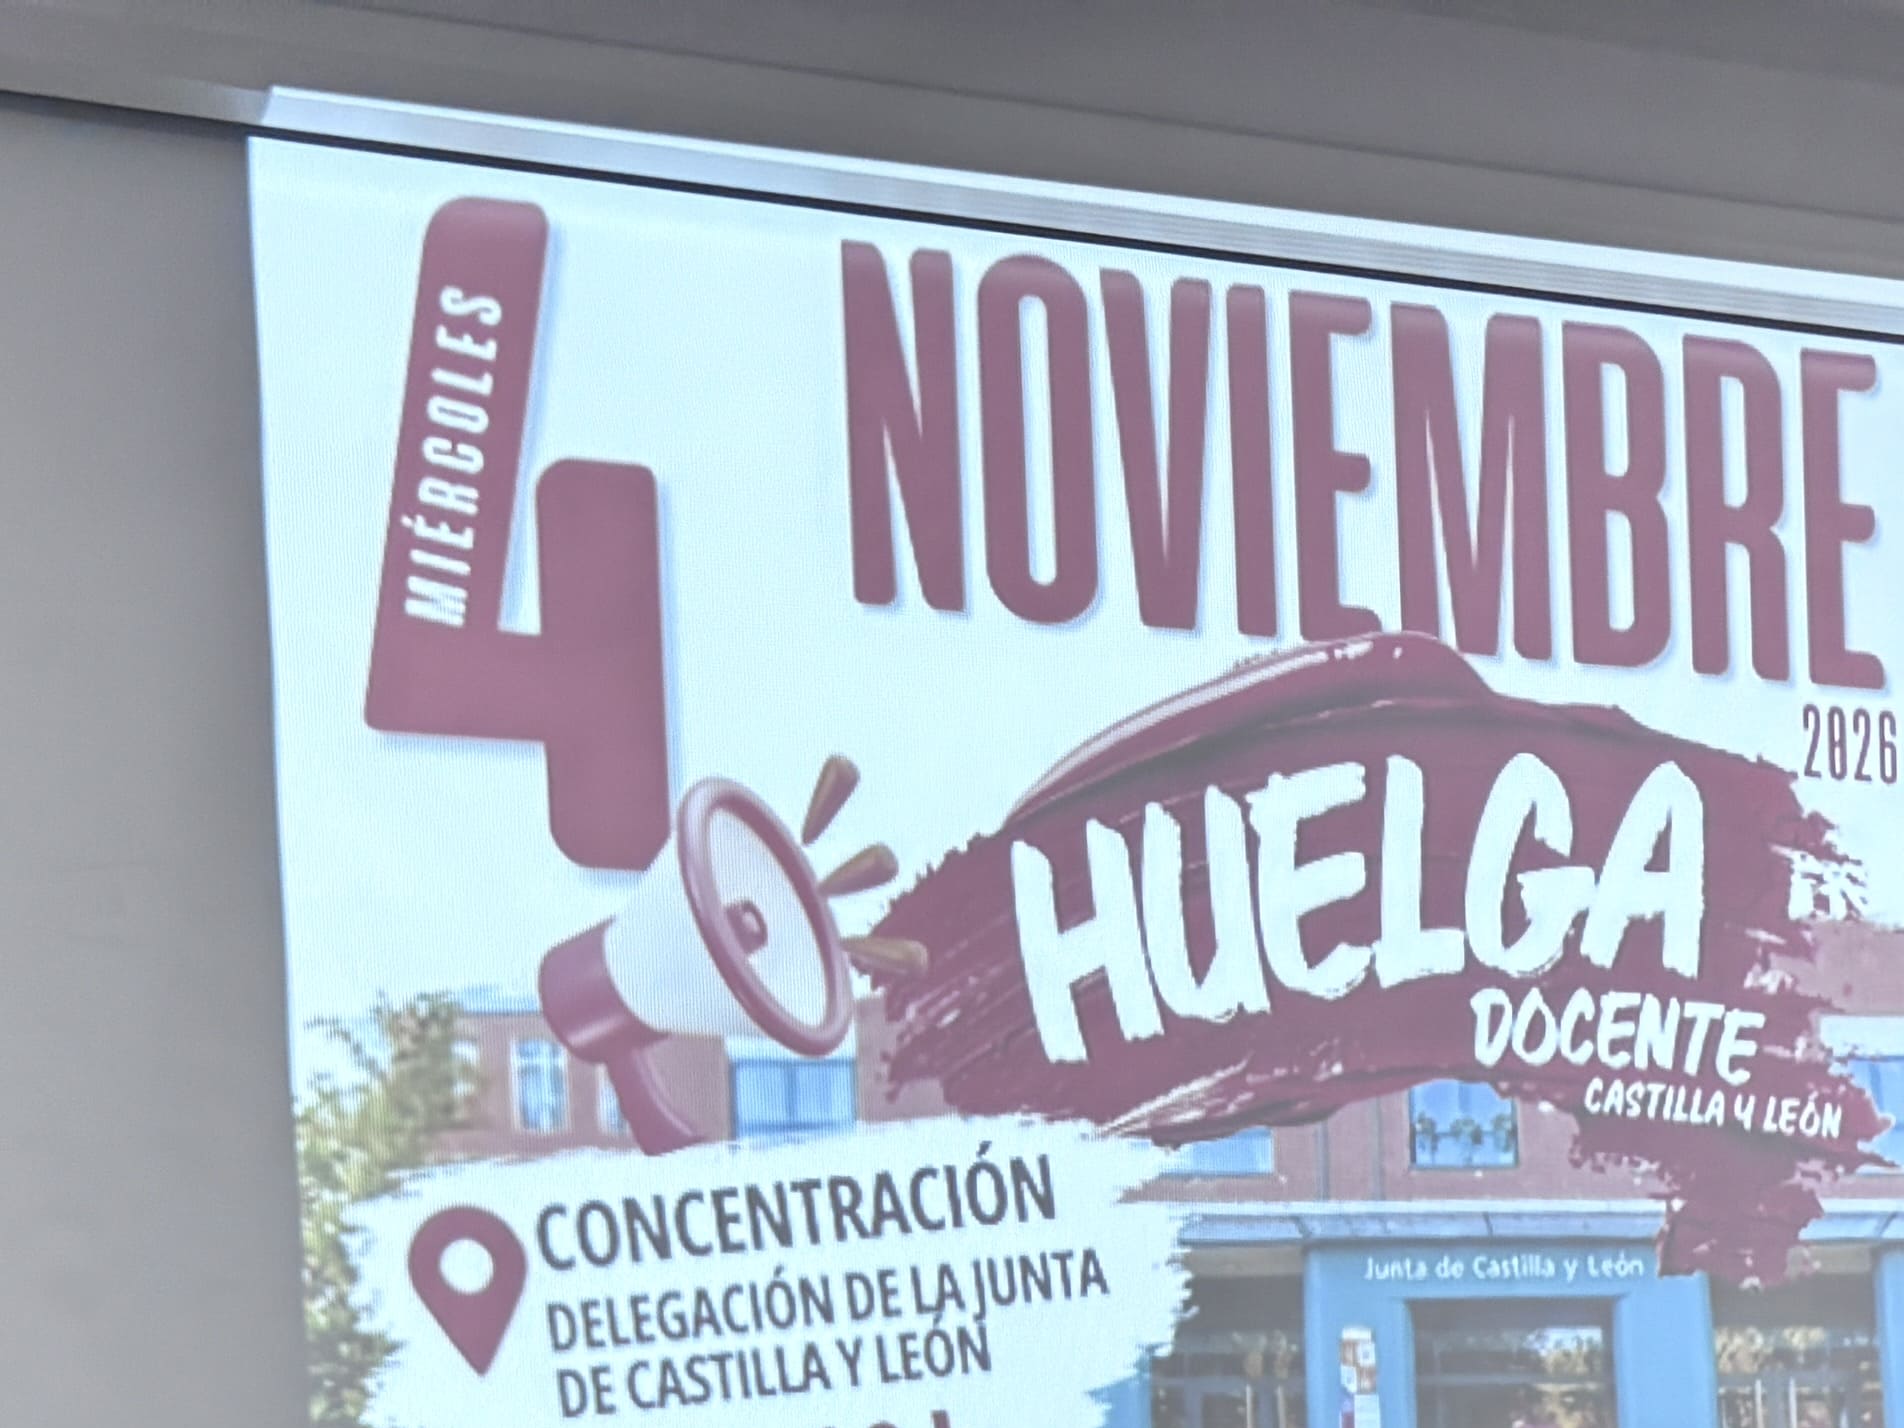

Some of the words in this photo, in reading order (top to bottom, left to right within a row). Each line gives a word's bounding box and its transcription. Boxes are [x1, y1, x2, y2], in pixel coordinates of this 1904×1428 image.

[403, 284, 504, 628] MIÉRCOLES
[841, 239, 1888, 692] NOVIEMBRE
[364, 197, 672, 871] 4
[1802, 701, 1898, 786] 2026
[1010, 753, 1705, 1064] HUELGA
[1470, 987, 1766, 1085] DOCENTE
[1584, 1076, 1726, 1127] CASTILLA
[1762, 1090, 1842, 1139] LEÓN
[536, 1142, 1058, 1271] CONCENTRACIÓN
[547, 1265, 836, 1352] DELEGACIÓN
[844, 1270, 902, 1320] DE
[909, 1263, 963, 1314] LA
[971, 1246, 1110, 1319] JUNTA
[1364, 1256, 1428, 1281] Junta
[1435, 1256, 1465, 1280] de
[1472, 1253, 1555, 1280] Castilla
[1563, 1258, 1580, 1283] y
[1587, 1252, 1644, 1279] León
[556, 1367, 618, 1419] DE
[626, 1341, 828, 1411] CASTILLA
[834, 1338, 865, 1386] Y
[878, 1319, 992, 1383] LEÓN
